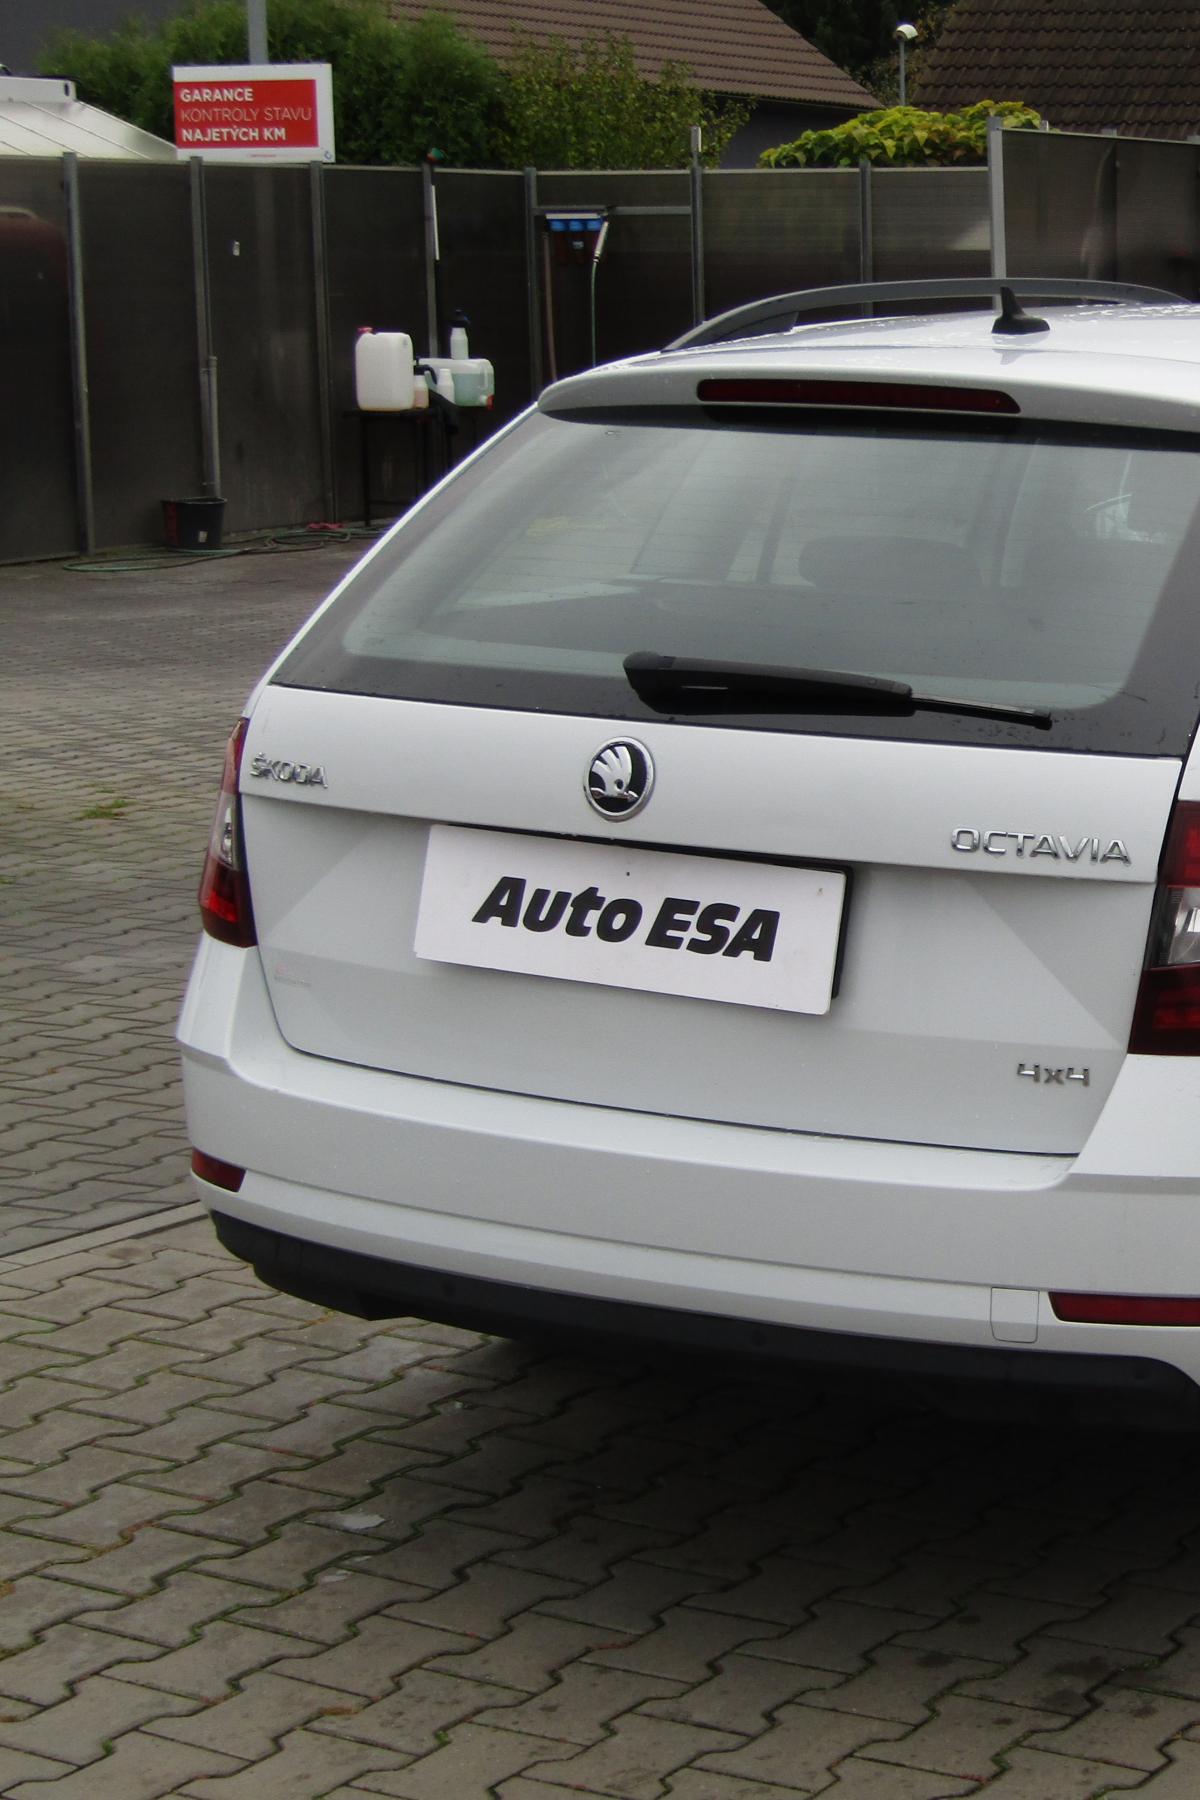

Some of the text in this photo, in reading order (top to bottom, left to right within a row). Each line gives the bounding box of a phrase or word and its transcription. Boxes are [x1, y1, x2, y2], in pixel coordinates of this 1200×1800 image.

[180, 88, 254, 102] GARANCE
[181, 107, 312, 122] KONTROLY STAVU
[182, 125, 286, 142] NAJETÝCH KM
[250, 751, 328, 789] ŠKODA
[951, 827, 1131, 866] OCTAVIA
[472, 876, 781, 962] Auto ESA
[1017, 1063, 1090, 1087] 4x4
